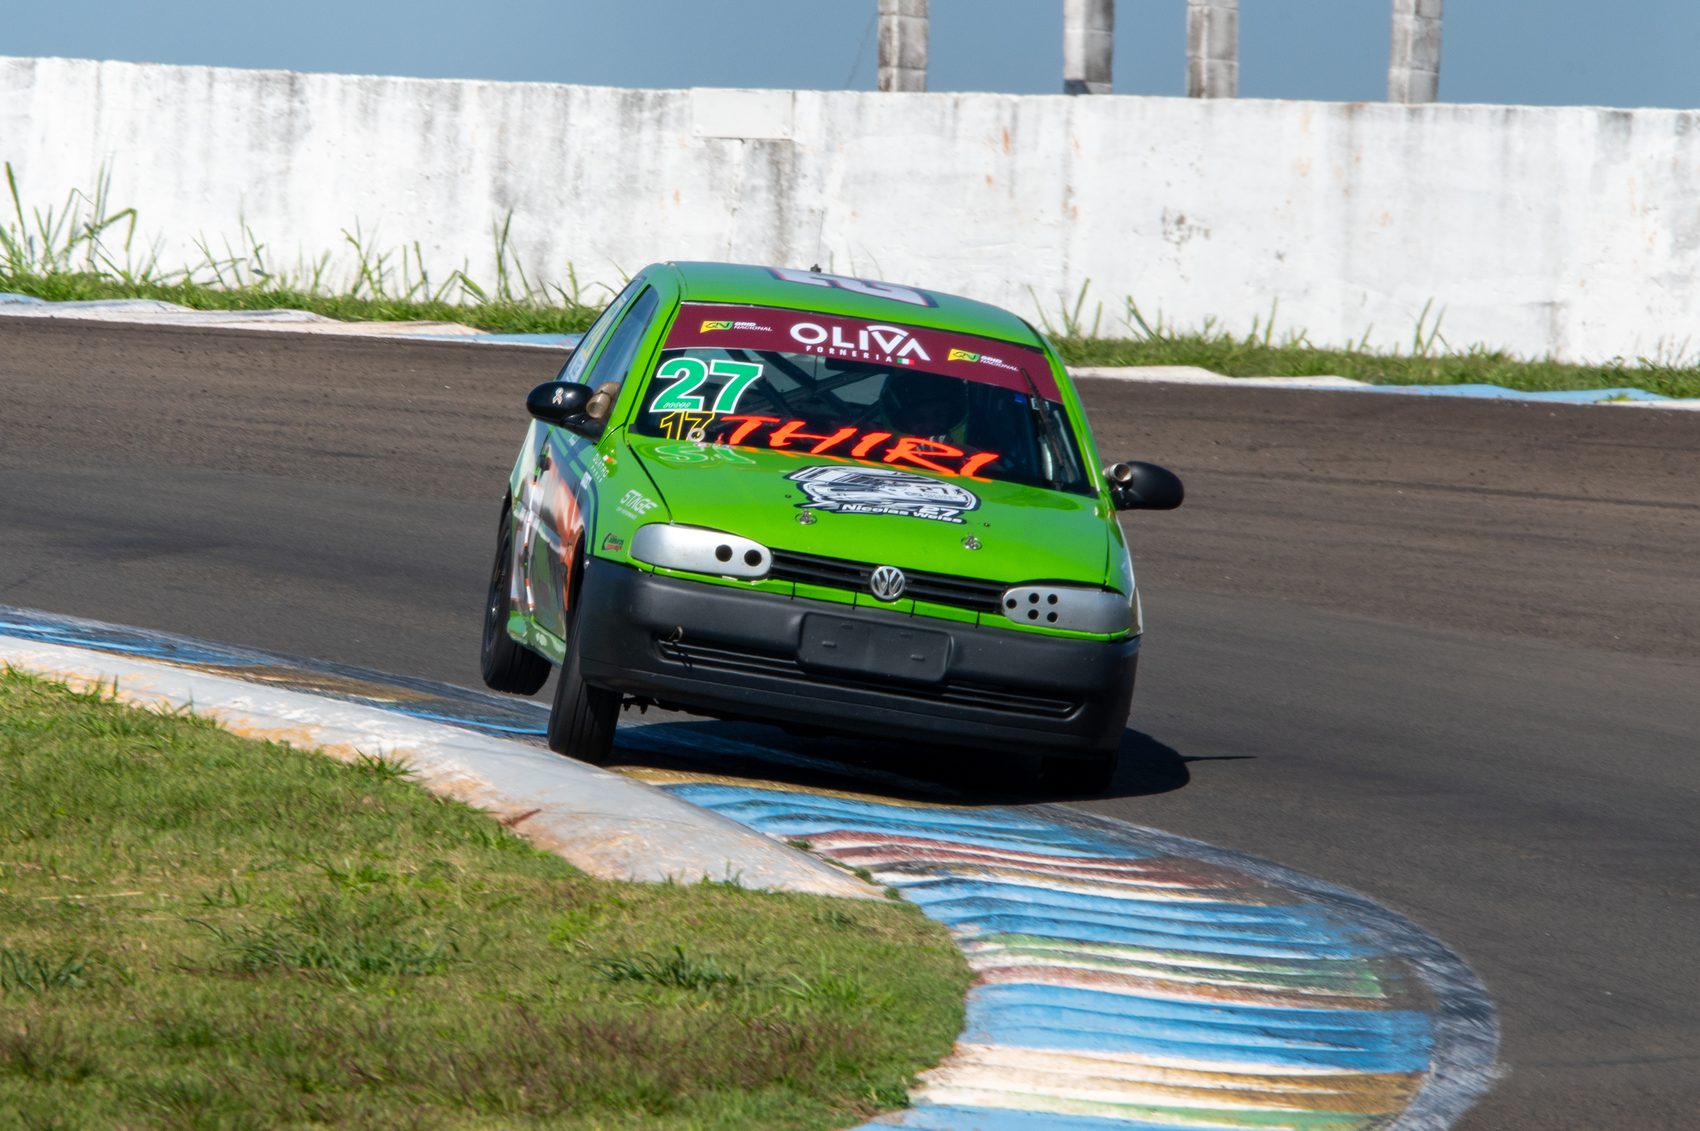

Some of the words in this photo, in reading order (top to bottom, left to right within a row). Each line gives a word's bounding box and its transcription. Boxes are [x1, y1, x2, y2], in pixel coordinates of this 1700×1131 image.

[790, 322, 931, 361] OLIVA
[806, 345, 892, 362] FORNERIA
[649, 357, 763, 414] 27
[660, 411, 716, 441] 17
[620, 489, 658, 515] STAGE
[841, 503, 909, 516] Nicolas
[913, 510, 963, 524] Weiss
[918, 505, 959, 517] 27
